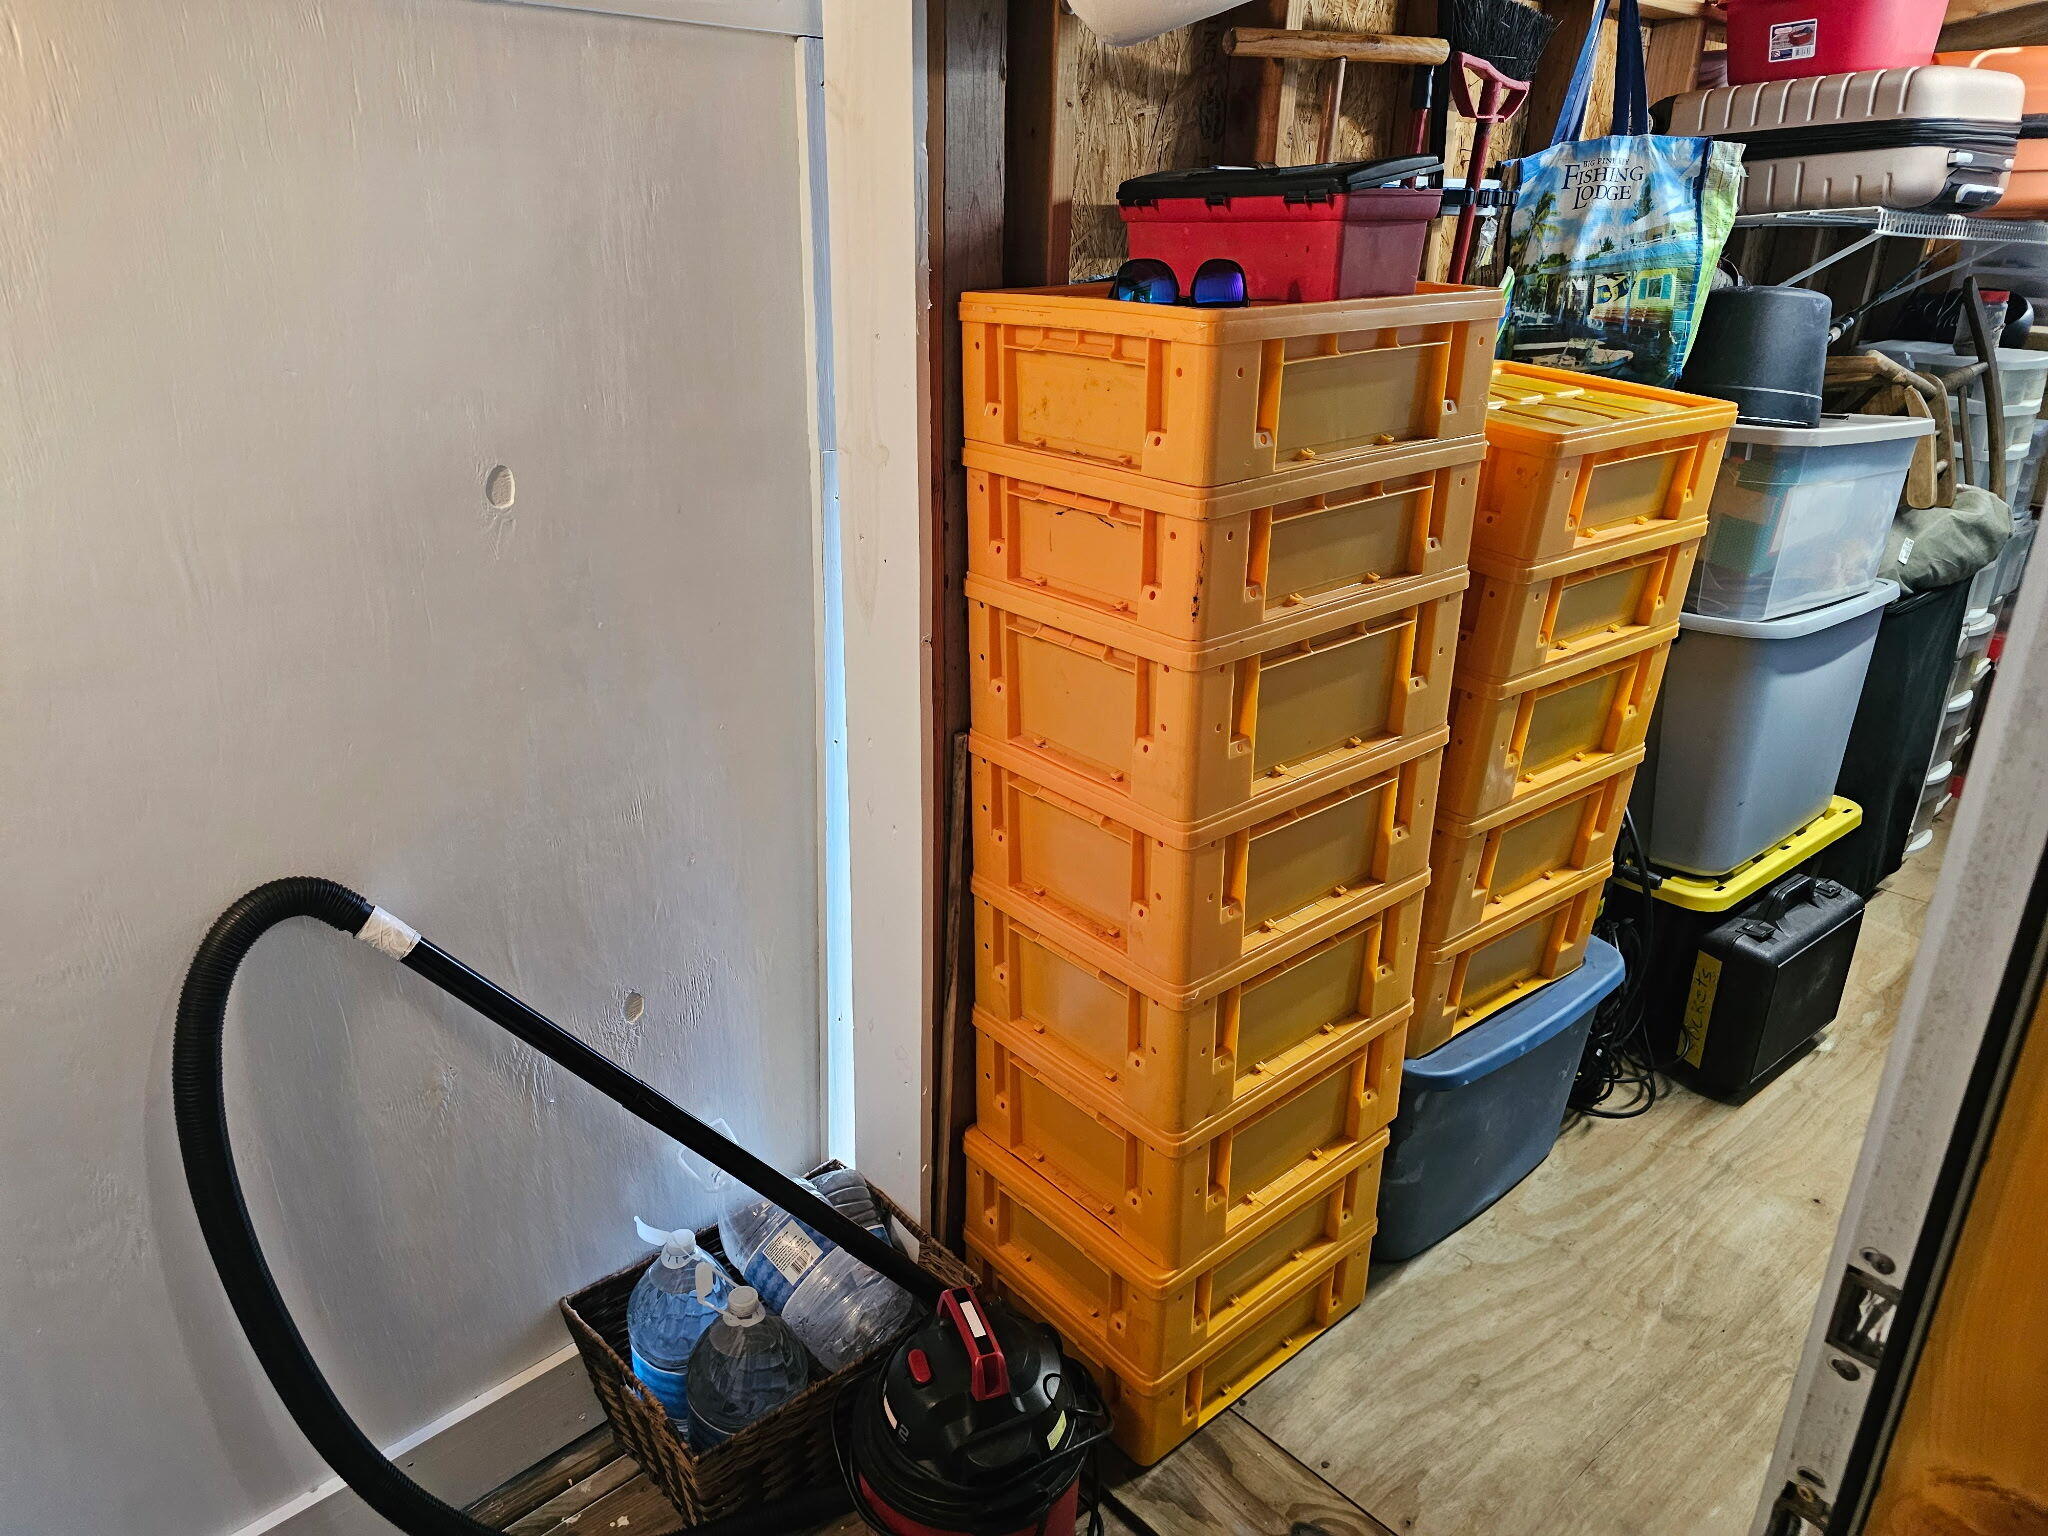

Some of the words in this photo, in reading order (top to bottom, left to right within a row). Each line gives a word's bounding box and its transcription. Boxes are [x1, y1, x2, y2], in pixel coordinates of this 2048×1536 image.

[1583, 159, 1596, 168] BIG
[1561, 164, 1645, 190] FISHING
[1572, 184, 1632, 210] LODGE
